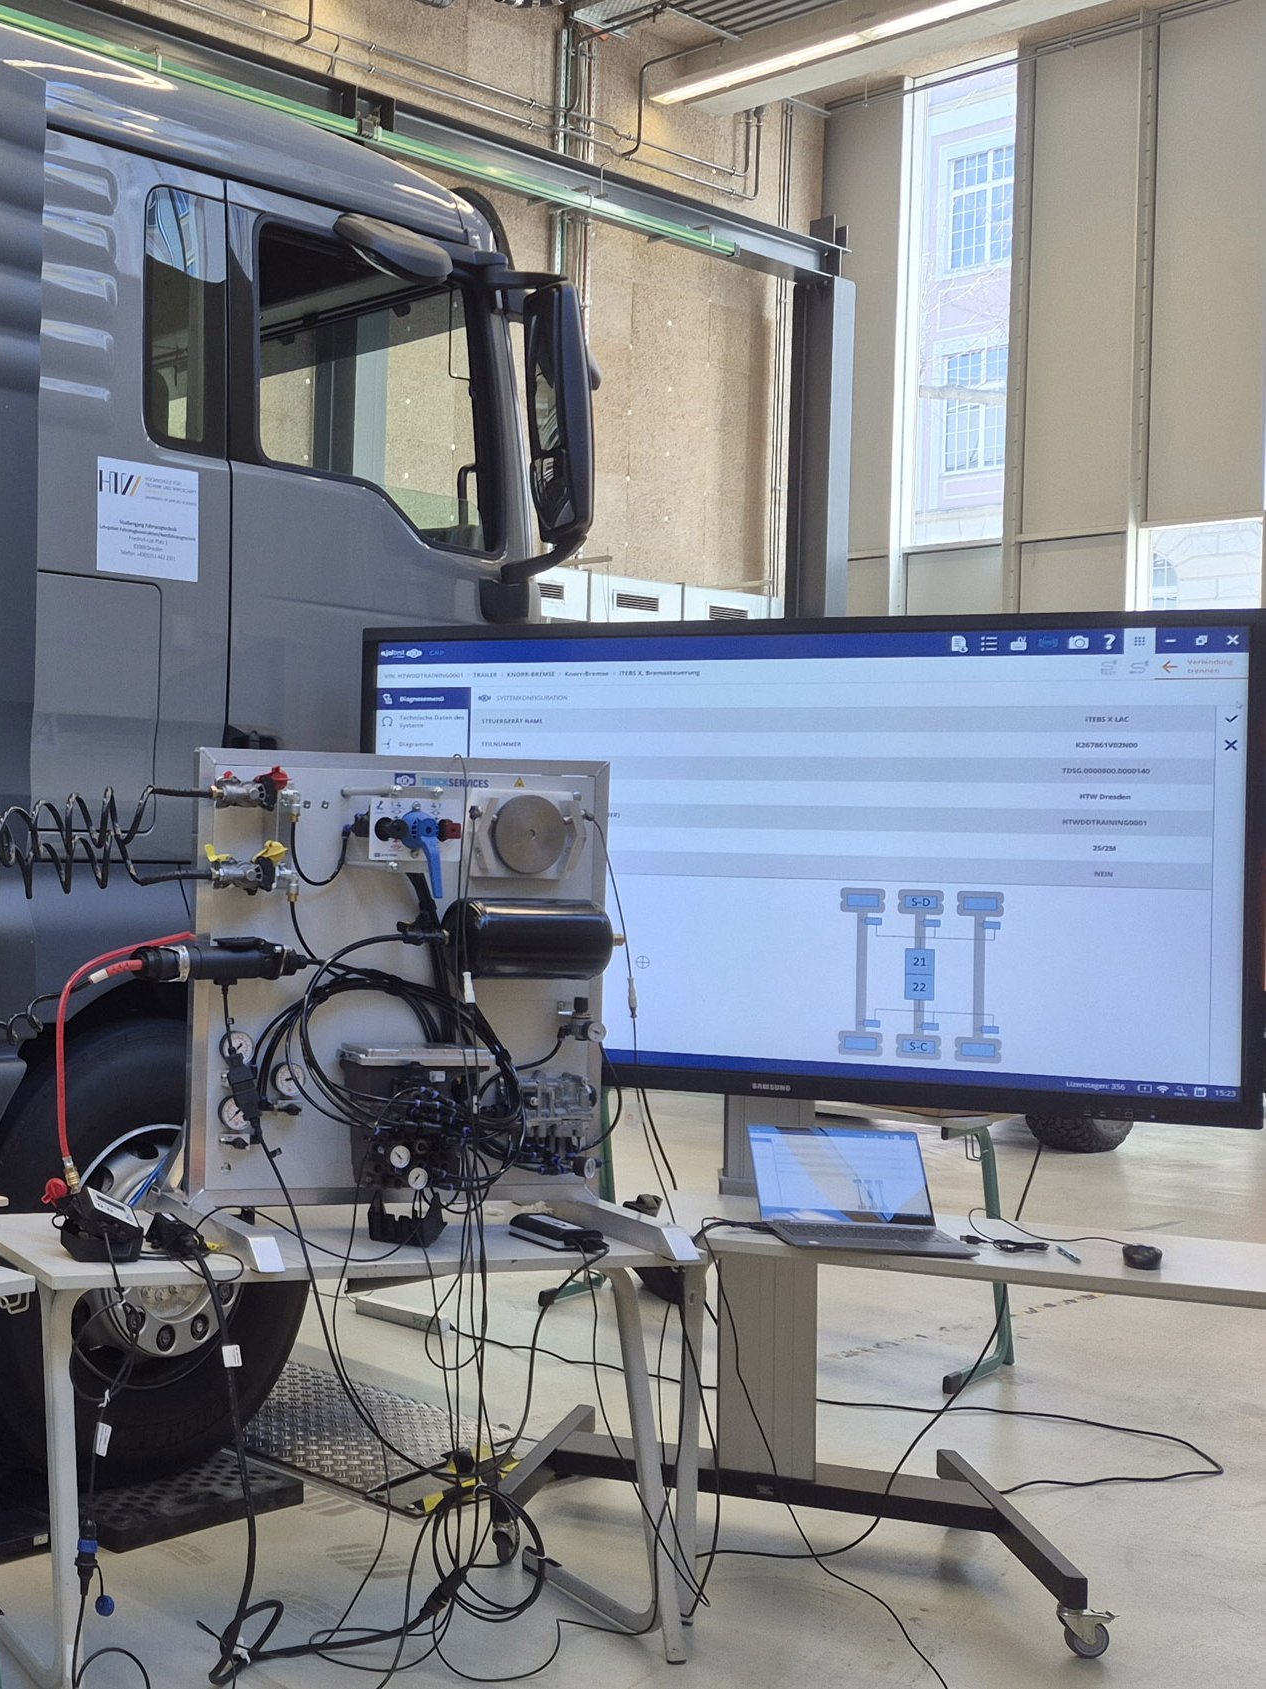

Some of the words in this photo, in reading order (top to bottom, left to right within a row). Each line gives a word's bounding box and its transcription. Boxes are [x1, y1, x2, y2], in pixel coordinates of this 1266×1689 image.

[1187, 658, 1234, 667] Verbindung
[399, 695, 445, 704] Diagnosemenü
[496, 694, 568, 702] SYSTEMKONFIGURATION
[911, 898, 931, 907] S-D
[913, 957, 927, 967] 21
[912, 983, 927, 992] 22
[909, 1042, 928, 1052] S-C
[751, 1083, 791, 1092] SAMSUNG
[1066, 1080, 1110, 1091] Lizenztagen:
[1111, 1083, 1126, 1091] 356
[1215, 1089, 1237, 1097] 15:23
